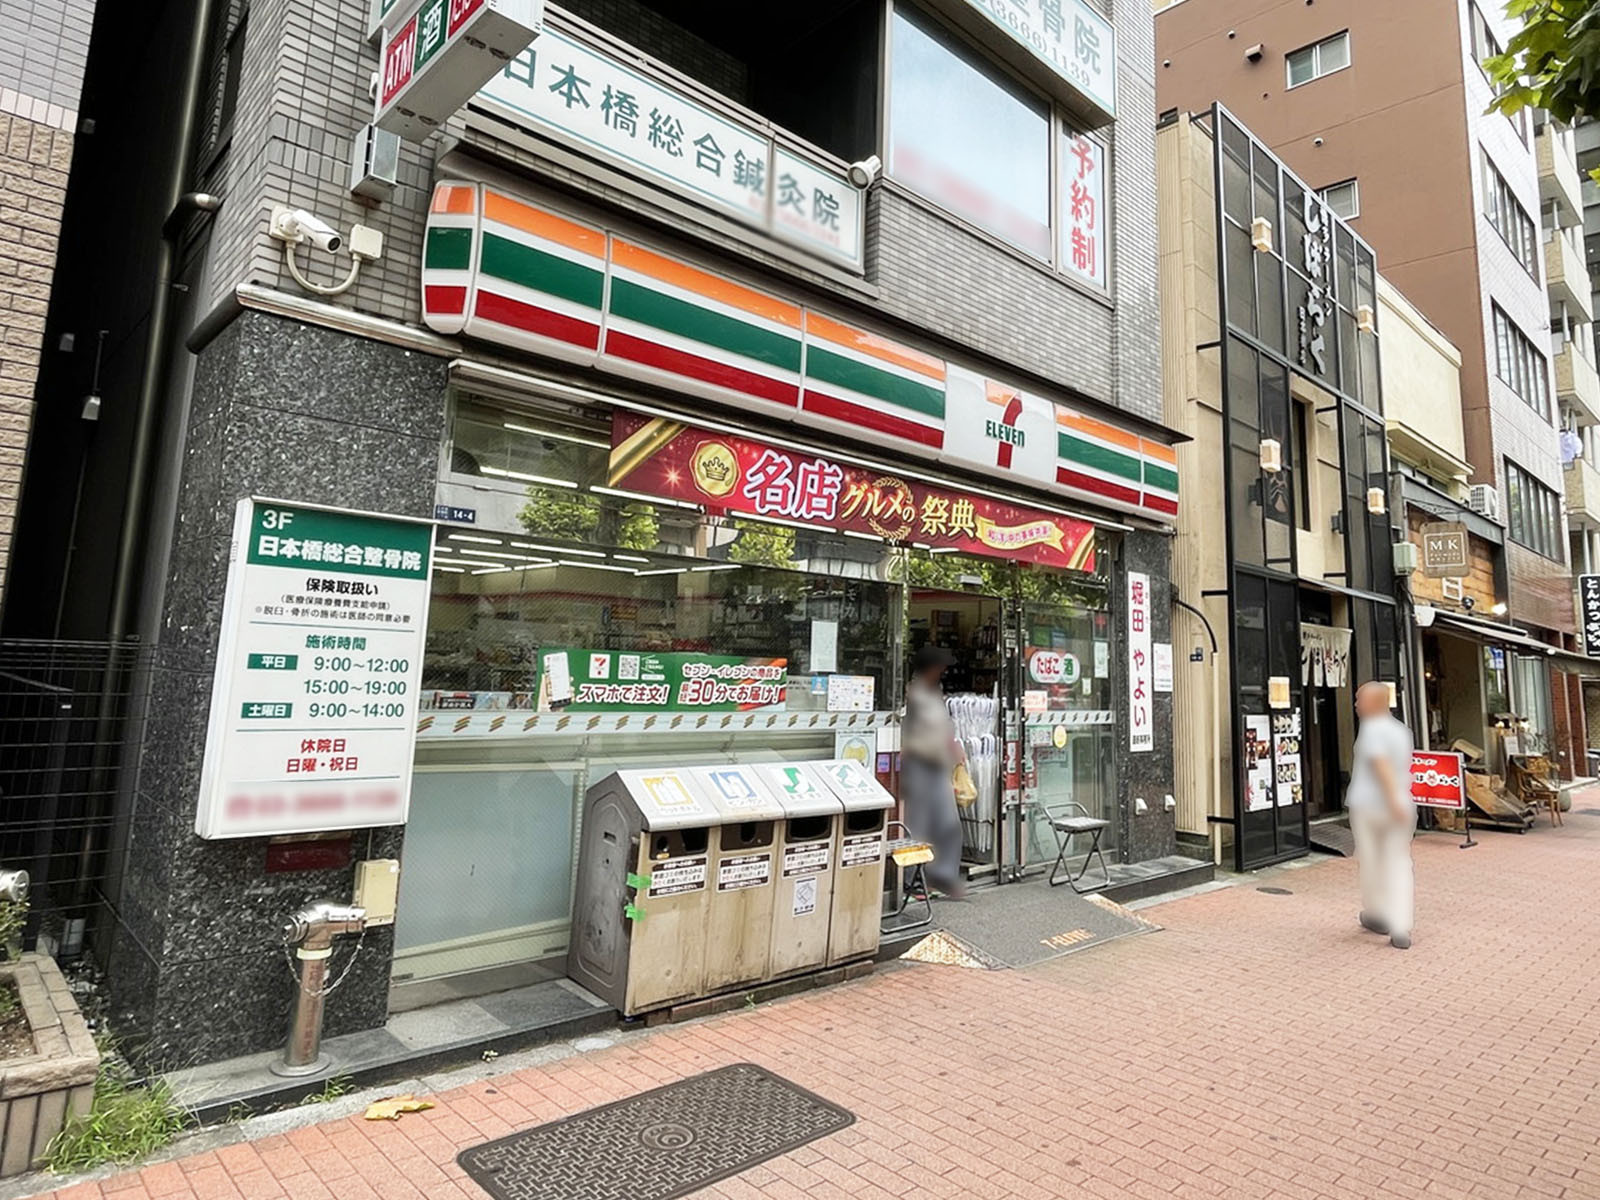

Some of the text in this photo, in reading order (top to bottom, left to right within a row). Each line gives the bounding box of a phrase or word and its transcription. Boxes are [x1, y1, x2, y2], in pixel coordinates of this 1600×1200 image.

[420, 0, 442, 61] 酒
[384, 31, 414, 98] ATM
[1070, 135, 1095, 277] 予約制
[262, 509, 293, 531] 3F
[258, 535, 422, 572] 日本橋総合整骨院
[1430, 539, 1459, 551] M K
[305, 577, 379, 596] 保険取扱い
[305, 634, 367, 651] 施術時間
[260, 655, 287, 669] 平日
[1036, 656, 1074, 676] たばこ 酒
[247, 703, 287, 718] 土曜日
[300, 738, 346, 754] 休院日
[286, 757, 359, 774] 日曜・祝日
